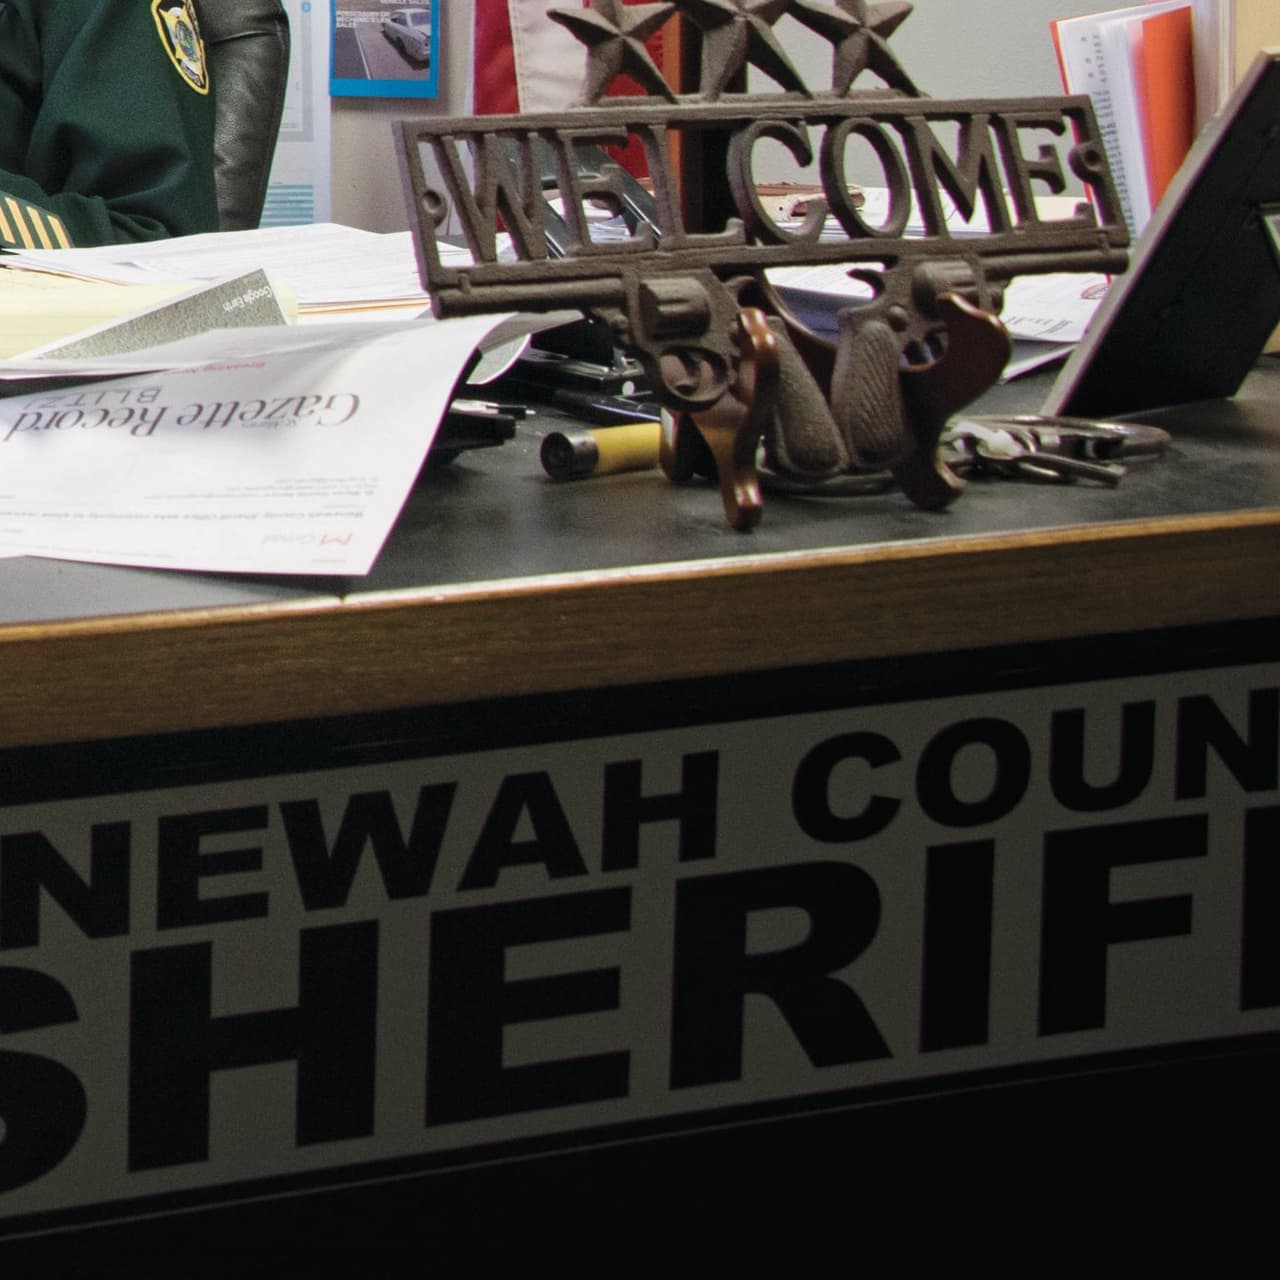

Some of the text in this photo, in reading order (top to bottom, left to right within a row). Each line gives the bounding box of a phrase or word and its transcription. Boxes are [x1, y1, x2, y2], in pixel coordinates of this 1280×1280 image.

[418, 112, 1096, 264] WELCOME
[222, 284, 273, 315] Google Earth
[4, 392, 361, 442] Gazette Record
